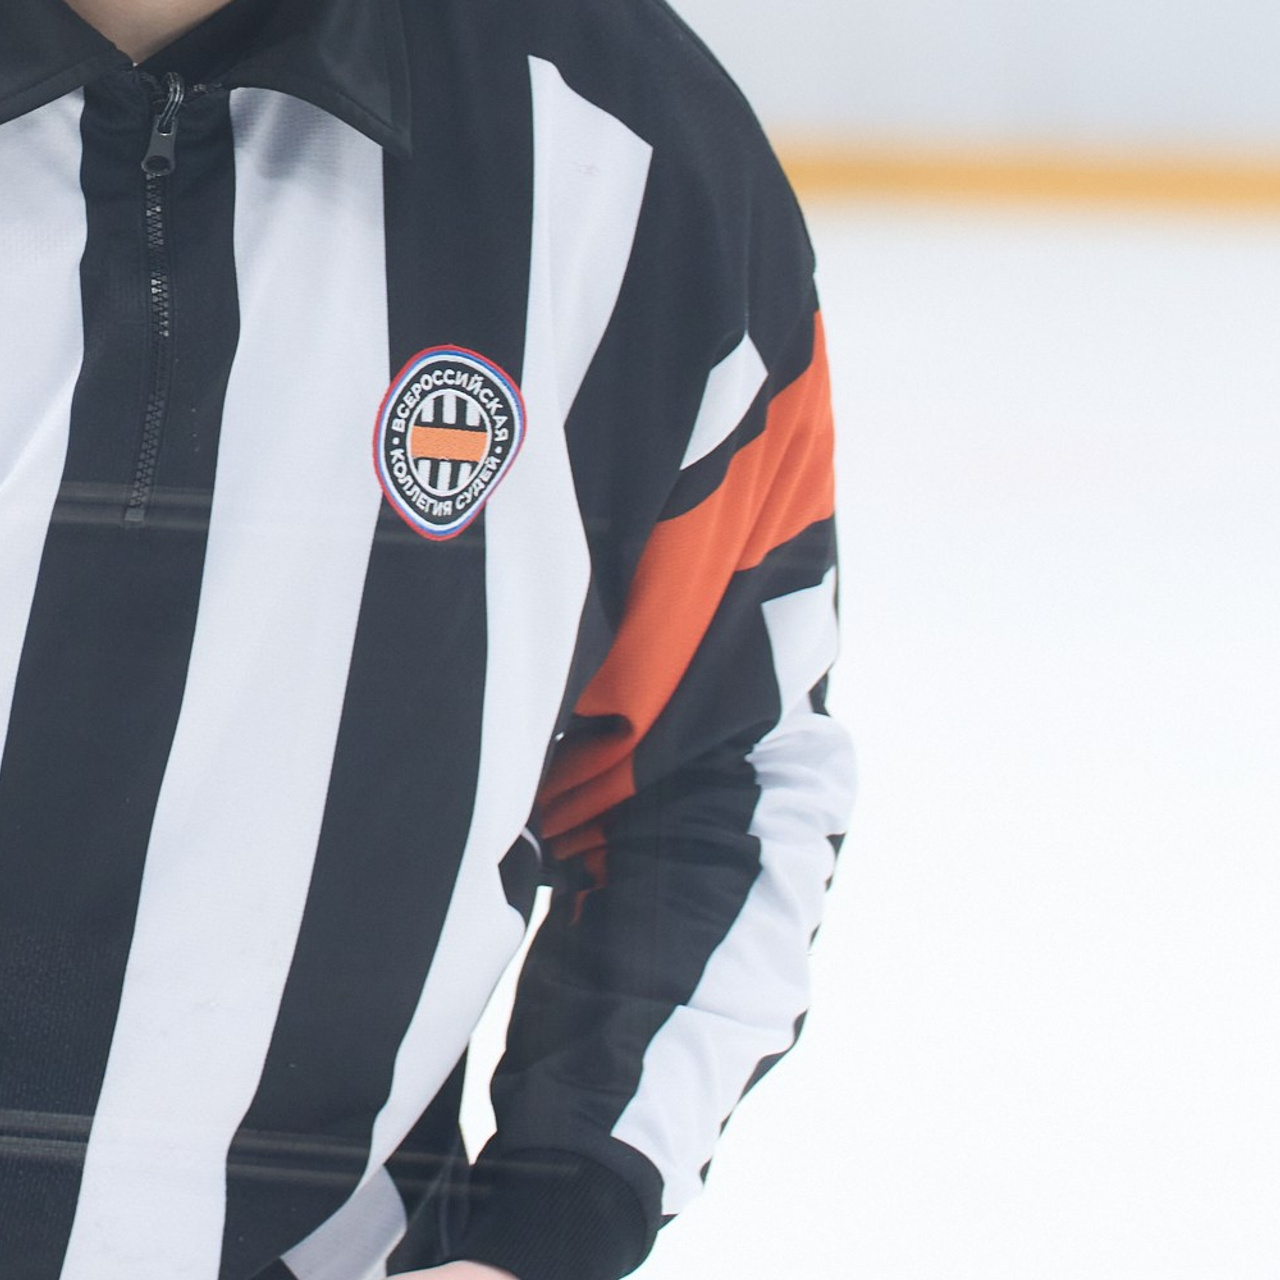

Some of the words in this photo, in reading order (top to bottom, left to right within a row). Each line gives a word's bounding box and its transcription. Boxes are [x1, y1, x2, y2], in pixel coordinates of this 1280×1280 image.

[391, 369, 509, 442] ВСЕРОССИЙСКАЯ
[390, 448, 453, 516] КОЛЛЕГИЯ
[455, 455, 501, 510] СУДЕЙ
